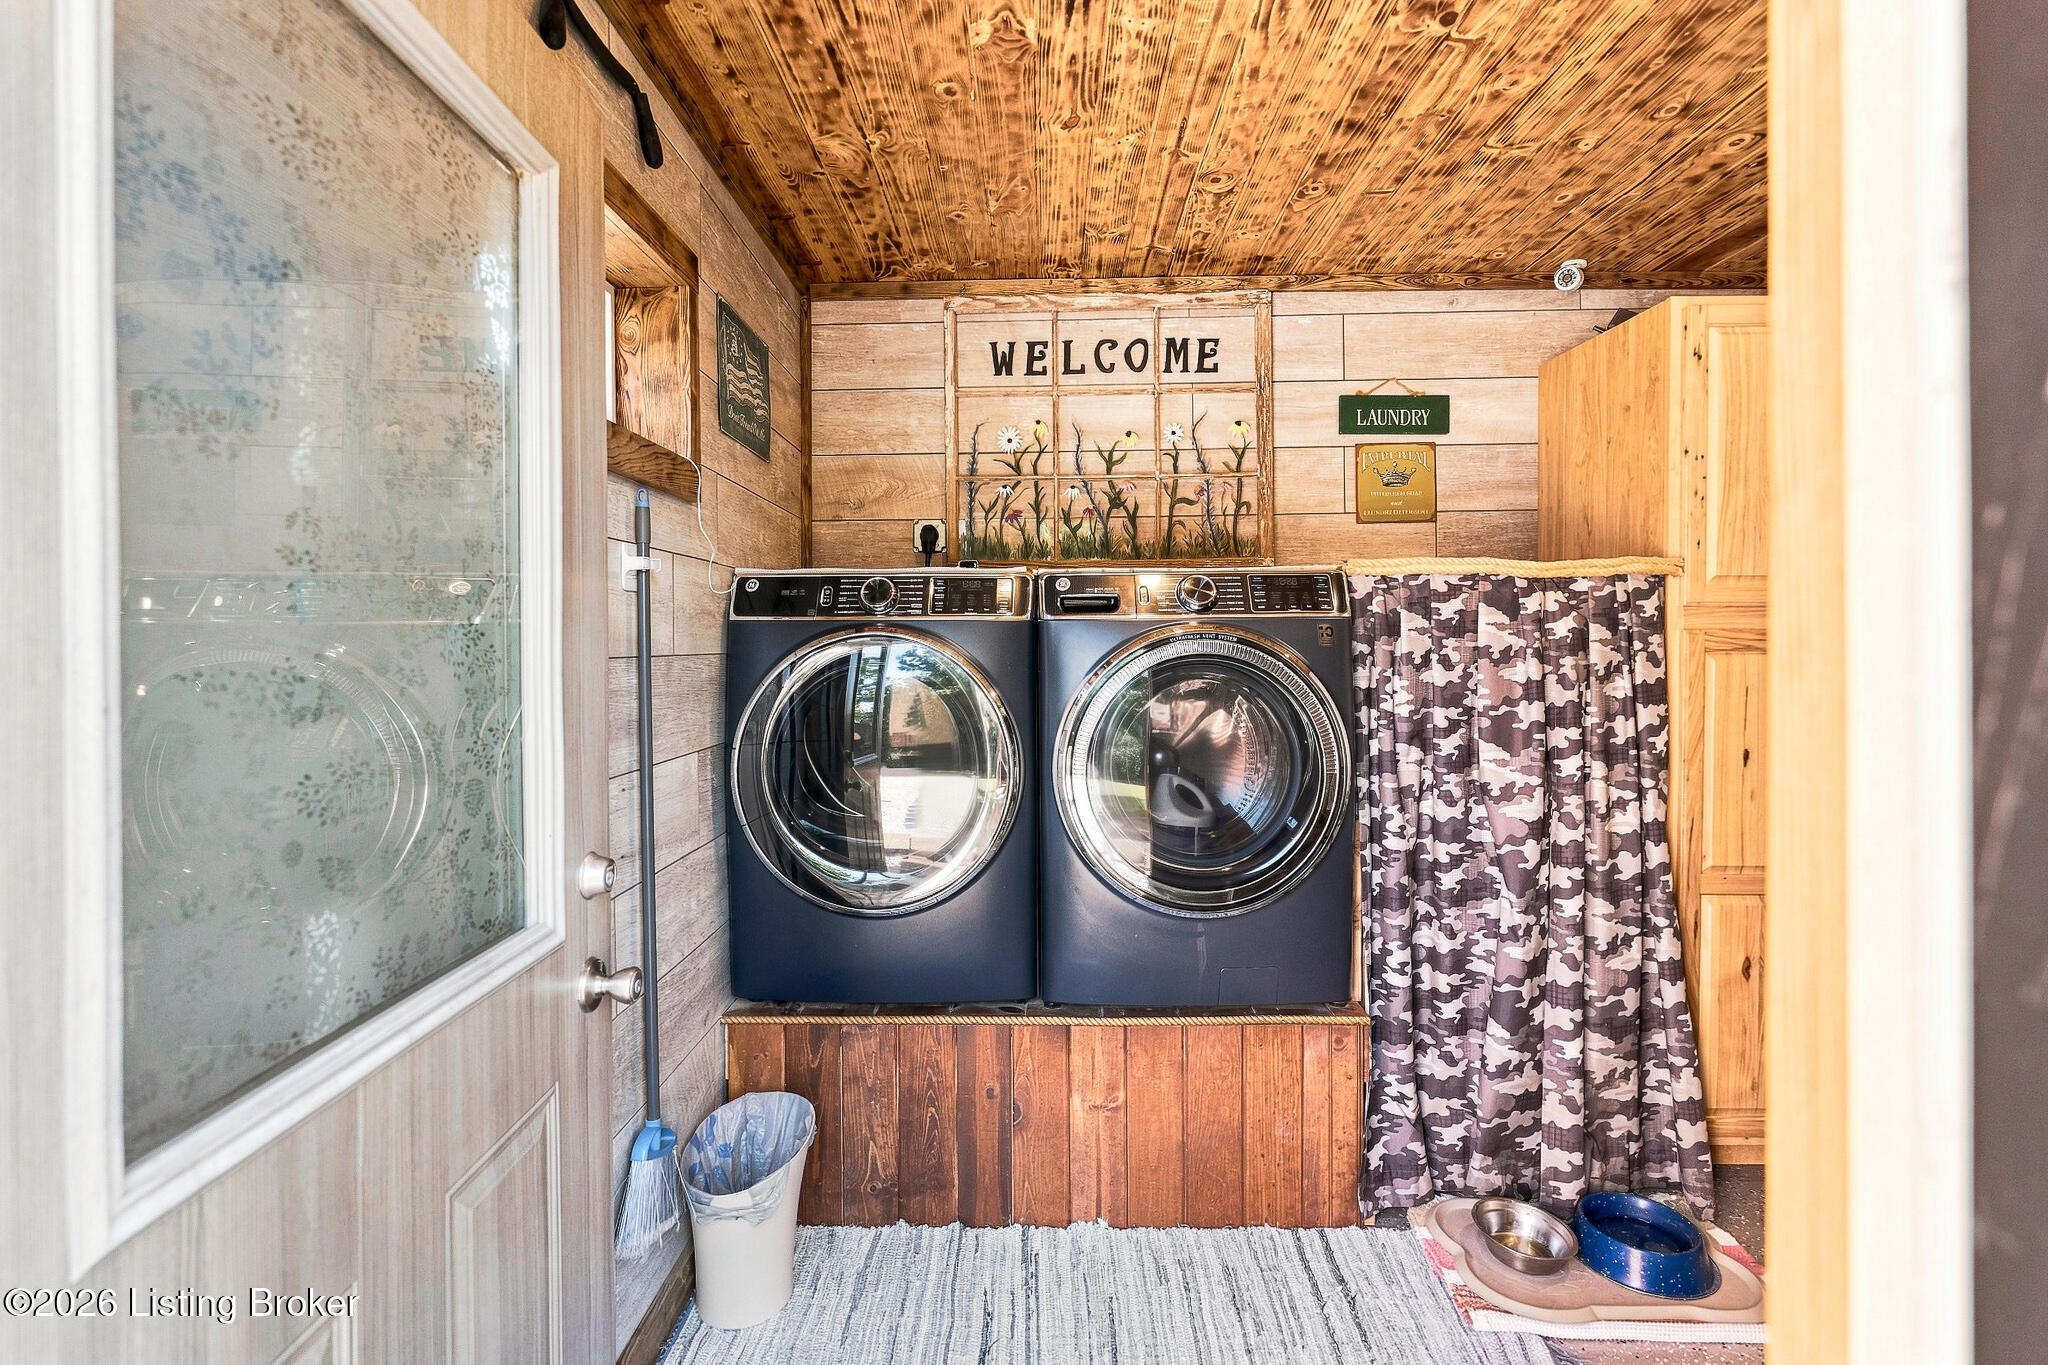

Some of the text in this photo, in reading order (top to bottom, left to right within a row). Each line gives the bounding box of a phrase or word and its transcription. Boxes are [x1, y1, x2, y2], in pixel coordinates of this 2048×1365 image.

[989, 337, 1221, 378] WELCOME
[1356, 408, 1431, 426] LAUNDRY
[1362, 450, 1431, 472] IMPERIAL
[1218, 634, 1238, 642] SYSTEM
